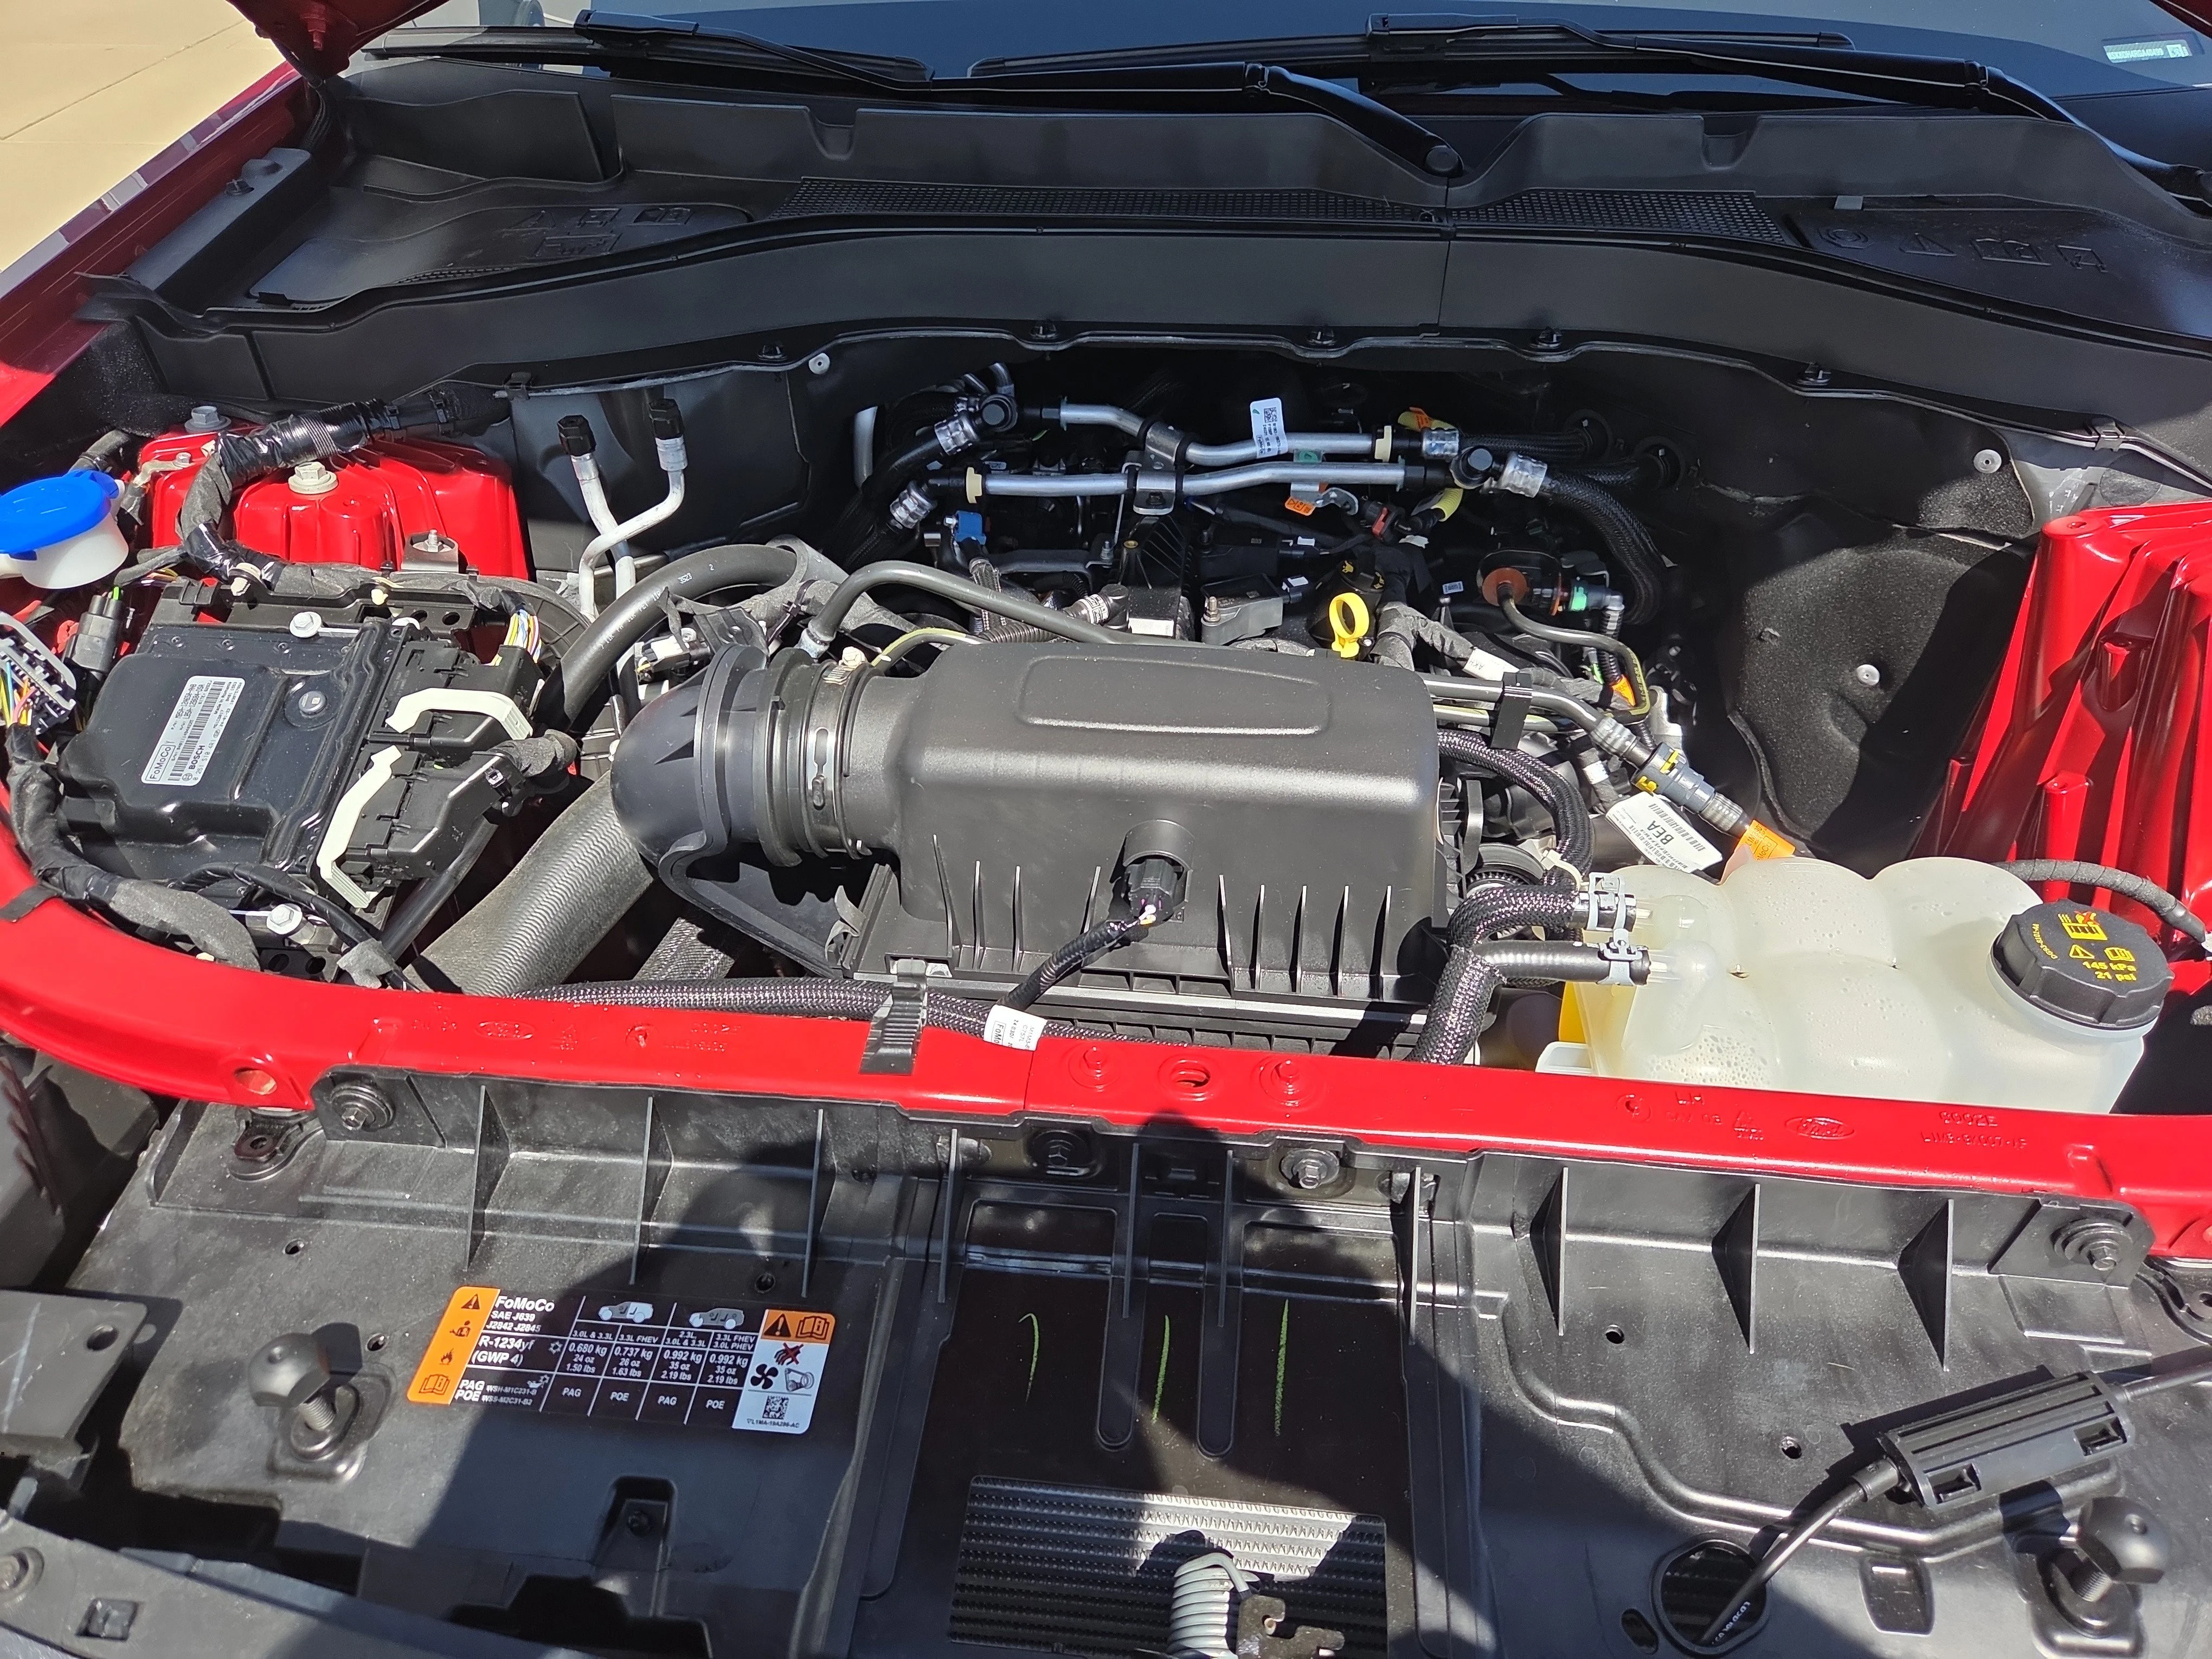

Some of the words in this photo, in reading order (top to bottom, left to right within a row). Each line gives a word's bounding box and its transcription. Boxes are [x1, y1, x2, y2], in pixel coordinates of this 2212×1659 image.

[221, 682, 232, 697] Romania
[189, 745, 205, 769] BOSCH
[149, 747, 171, 779] FoMoCo
[1647, 820, 1674, 845] BEA
[1757, 843, 1772, 860] MoCo
[2082, 961, 2108, 969] 145
[2109, 963, 2136, 971] kPa
[2095, 971, 2112, 979] 21
[994, 1024, 1004, 1043] FoMo
[495, 1295, 555, 1312] FoMoCo
[491, 1310, 512, 1320] SAE
[512, 1312, 536, 1322] J639
[486, 1321, 513, 1330] J2842
[513, 1323, 541, 1333] J2845
[478, 1335, 535, 1352] R-1234yf
[636, 1335, 658, 1343] FHEV
[569, 1342, 594, 1353] 0.680
[595, 1345, 607, 1357] kg
[731, 1342, 754, 1351] PHEV
[471, 1350, 509, 1364] (GWP
[510, 1354, 524, 1367] 4)
[573, 1354, 584, 1362] 24
[614, 1346, 640, 1357] 0.737
[641, 1348, 653, 1361] kg
[663, 1350, 689, 1360] 0.992
[690, 1352, 703, 1364] kg
[668, 1361, 679, 1369] 35
[710, 1354, 735, 1365] 0.992
[736, 1356, 748, 1368] kg
[566, 1363, 582, 1372] 1.50
[583, 1365, 596, 1373] lbs
[613, 1367, 628, 1376] 1.63
[629, 1368, 641, 1377] lbs
[715, 1365, 725, 1374] 35
[660, 1370, 678, 1380] 2.19
[679, 1371, 692, 1380] lbs
[707, 1374, 724, 1384] 2.19
[725, 1375, 738, 1385] lbs
[459, 1379, 485, 1390] PAG
[454, 1390, 482, 1401] POE
[562, 1387, 582, 1397] PAG
[609, 1391, 629, 1401] POE
[657, 1396, 677, 1406] PAG
[705, 1399, 725, 1410] POE
